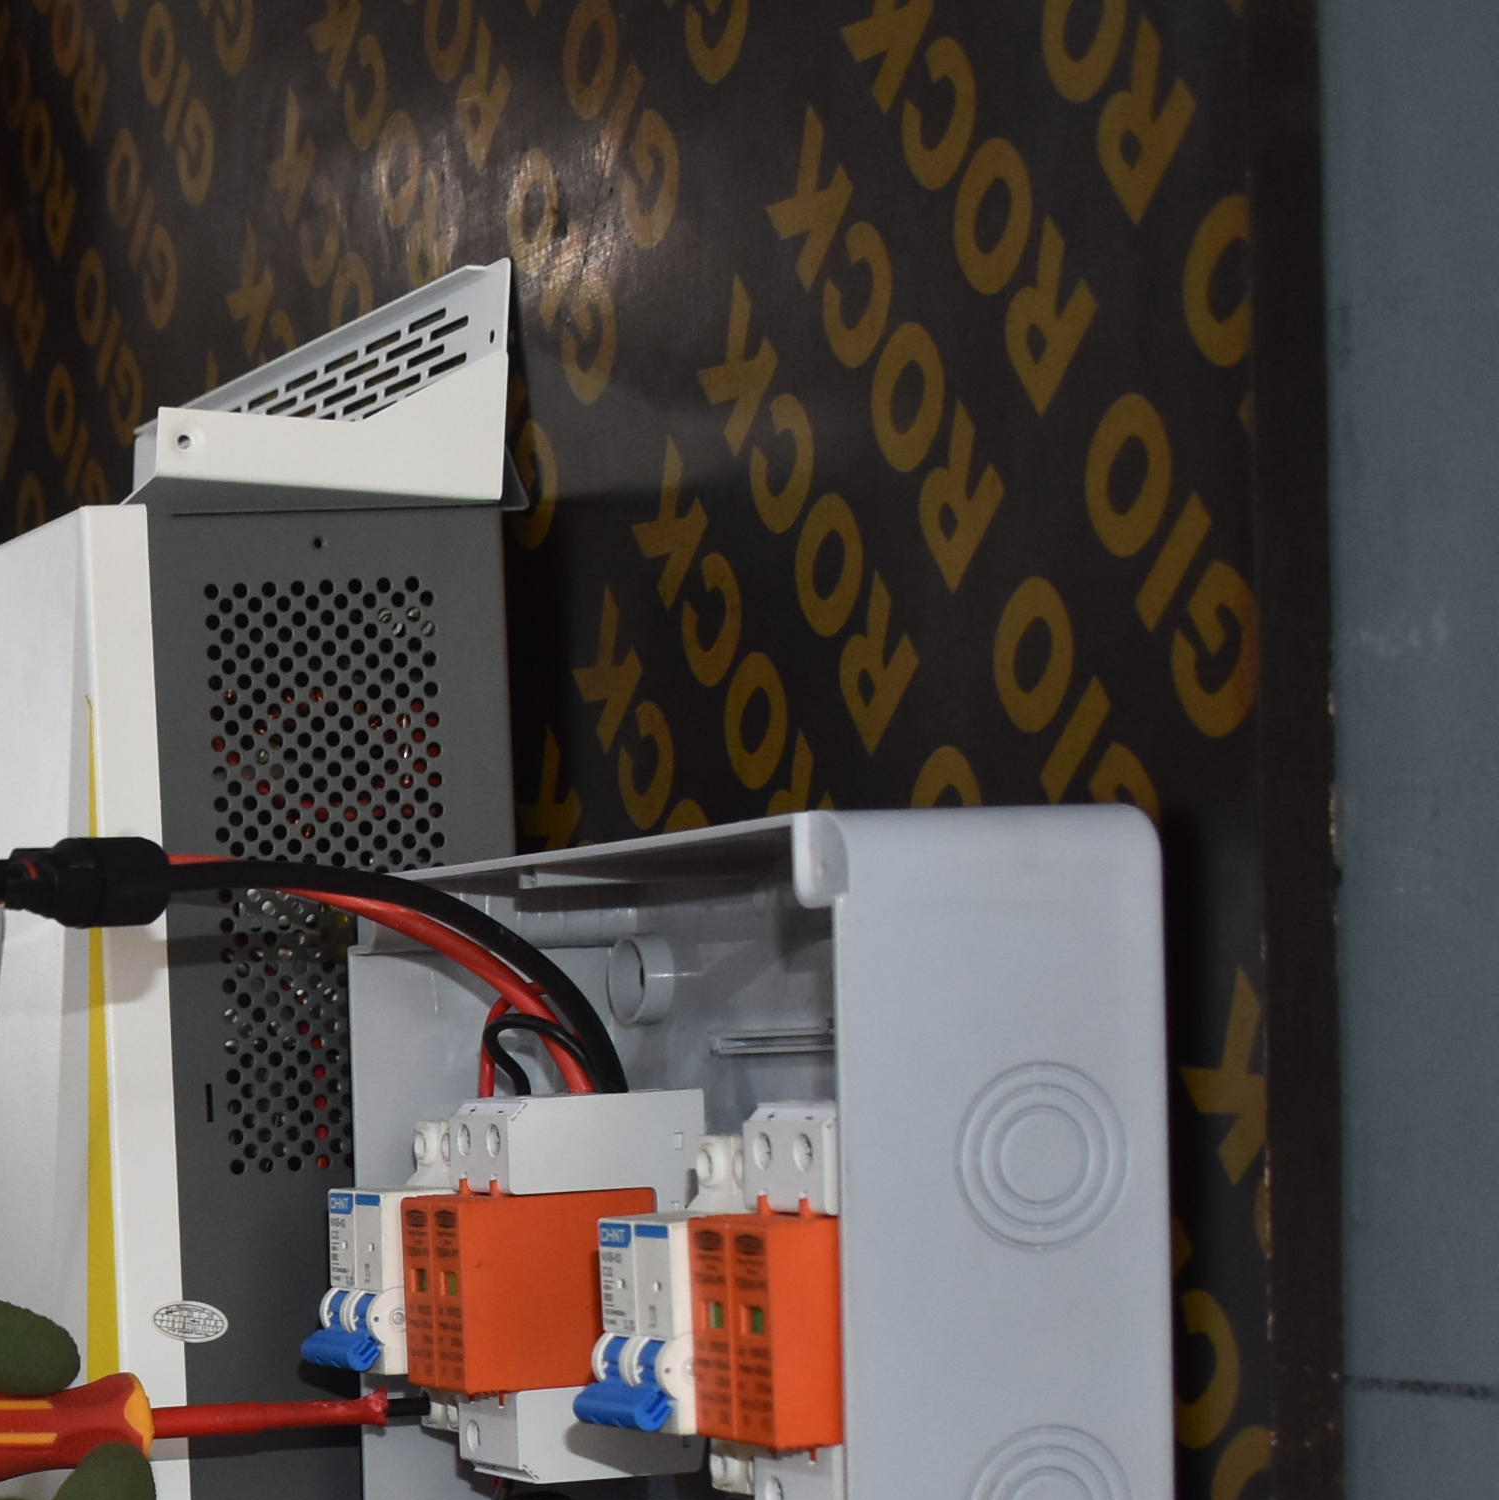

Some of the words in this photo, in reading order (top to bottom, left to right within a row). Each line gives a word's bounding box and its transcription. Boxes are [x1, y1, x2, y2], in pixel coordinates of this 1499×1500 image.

[139, 2, 214, 208] GIO
[423, 0, 510, 171] RO
[563, 0, 679, 249] GIO
[1042, 0, 1197, 225] RO
[107, 128, 178, 331] GIO
[841, 0, 1097, 415] ROCK
[74, 247, 144, 448] GIO
[766, 104, 1004, 594] ROCK
[697, 274, 920, 757] ROCK
[1085, 393, 1255, 738] GIO
